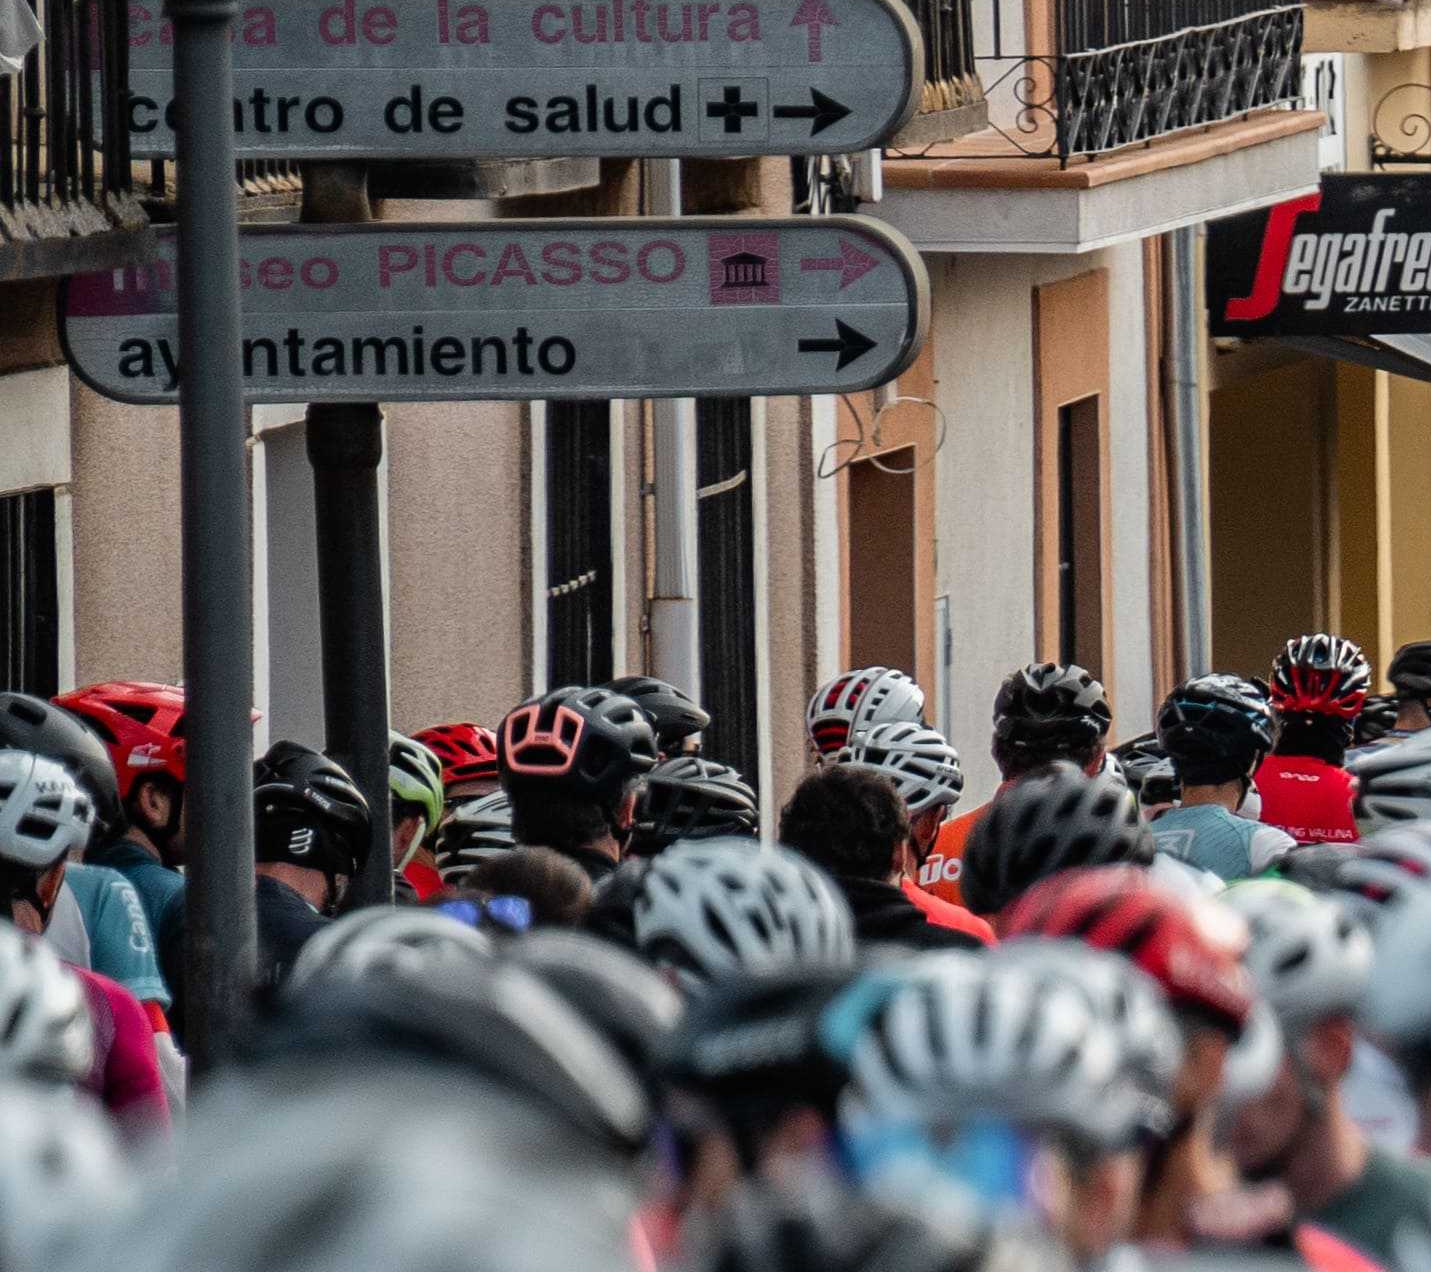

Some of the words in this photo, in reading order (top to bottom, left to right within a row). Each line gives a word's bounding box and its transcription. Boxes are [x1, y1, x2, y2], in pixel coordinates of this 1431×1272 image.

[127, 4, 279, 47] ca
[126, 87, 345, 134] ctro
[383, 84, 465, 134] de
[503, 83, 683, 134] salud
[112, 256, 340, 292] meo
[377, 239, 687, 290] PICASSO
[117, 324, 577, 392] ayntamiento
